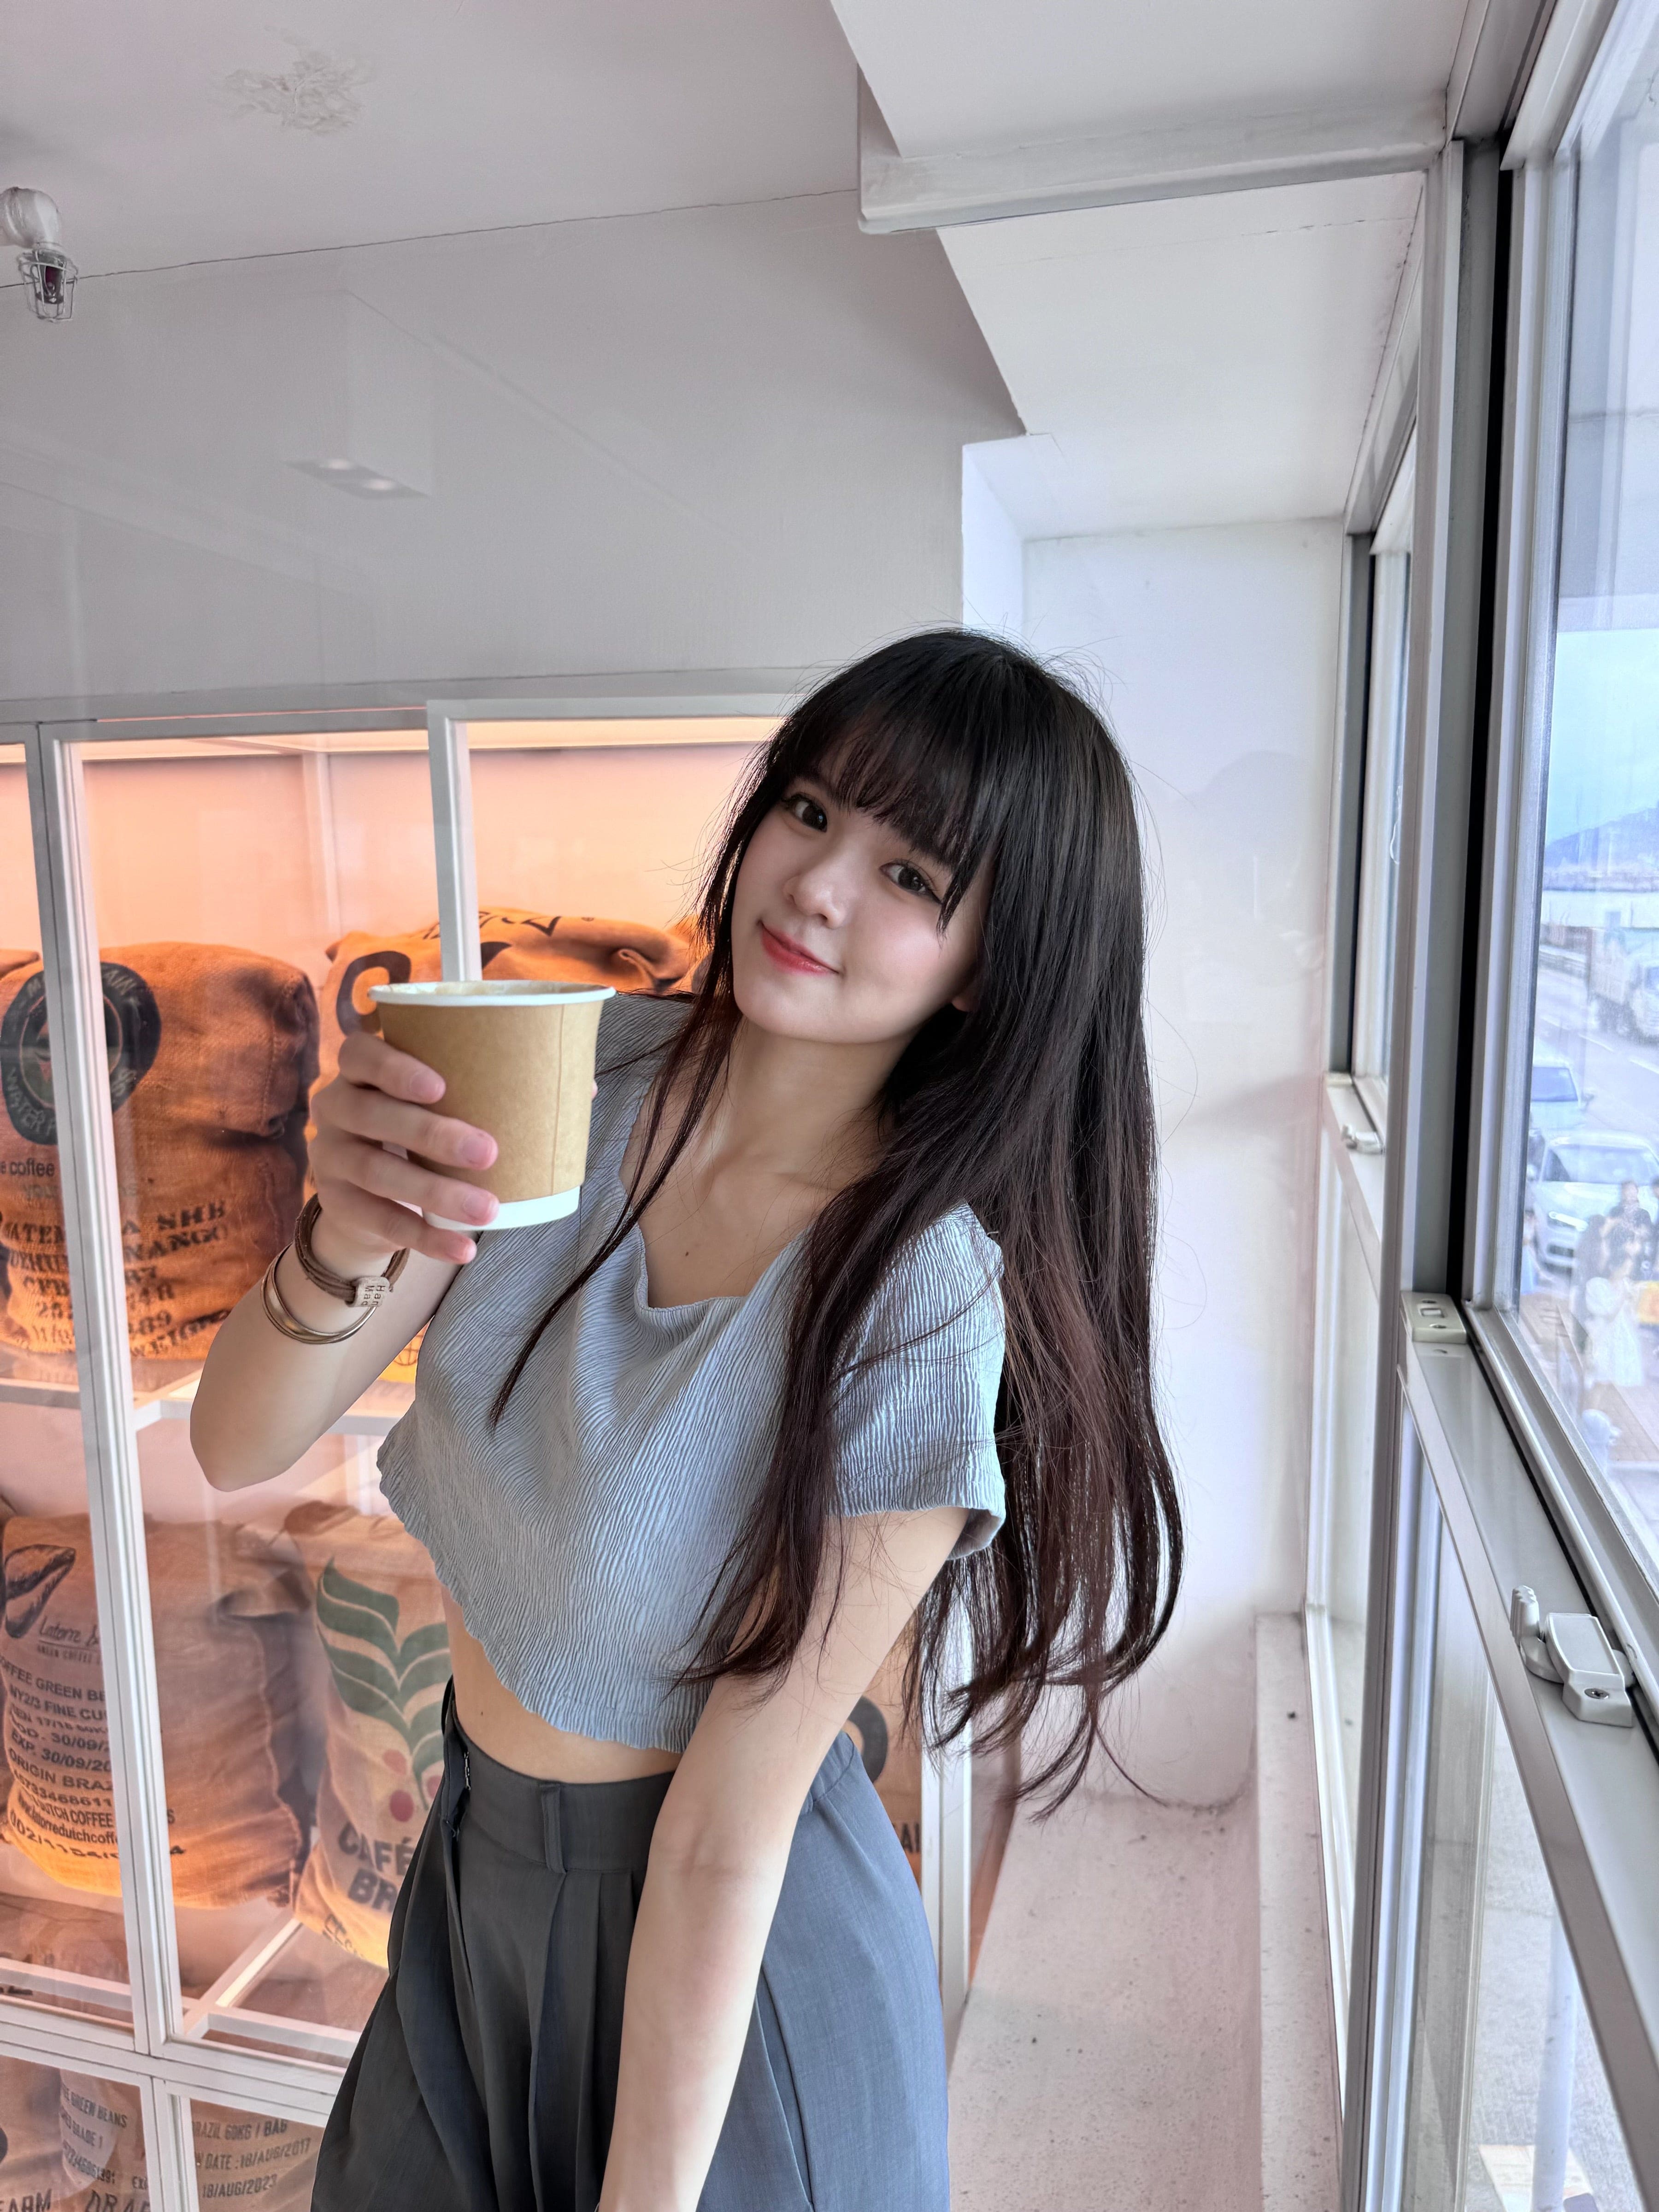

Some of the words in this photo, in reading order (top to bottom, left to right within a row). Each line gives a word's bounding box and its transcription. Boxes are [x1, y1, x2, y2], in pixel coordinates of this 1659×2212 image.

[9, 1158, 55, 1177] coffee
[371, 1285, 386, 1306] Han
[35, 1677, 82, 1700] GREEN
[44, 1700, 77, 1718] FINE
[9, 1747, 56, 1784] ORIGIN
[63, 1775, 113, 1791] BRAZ
[41, 1747, 112, 1772] 30/09/20
[70, 1809, 114, 1828] COFFEE
[338, 1821, 416, 1876] CAFÉ
[97, 2105, 128, 2128] BEANS
[205, 2152, 232, 2170] DATE
[0, 2188, 52, 2212] ARM
